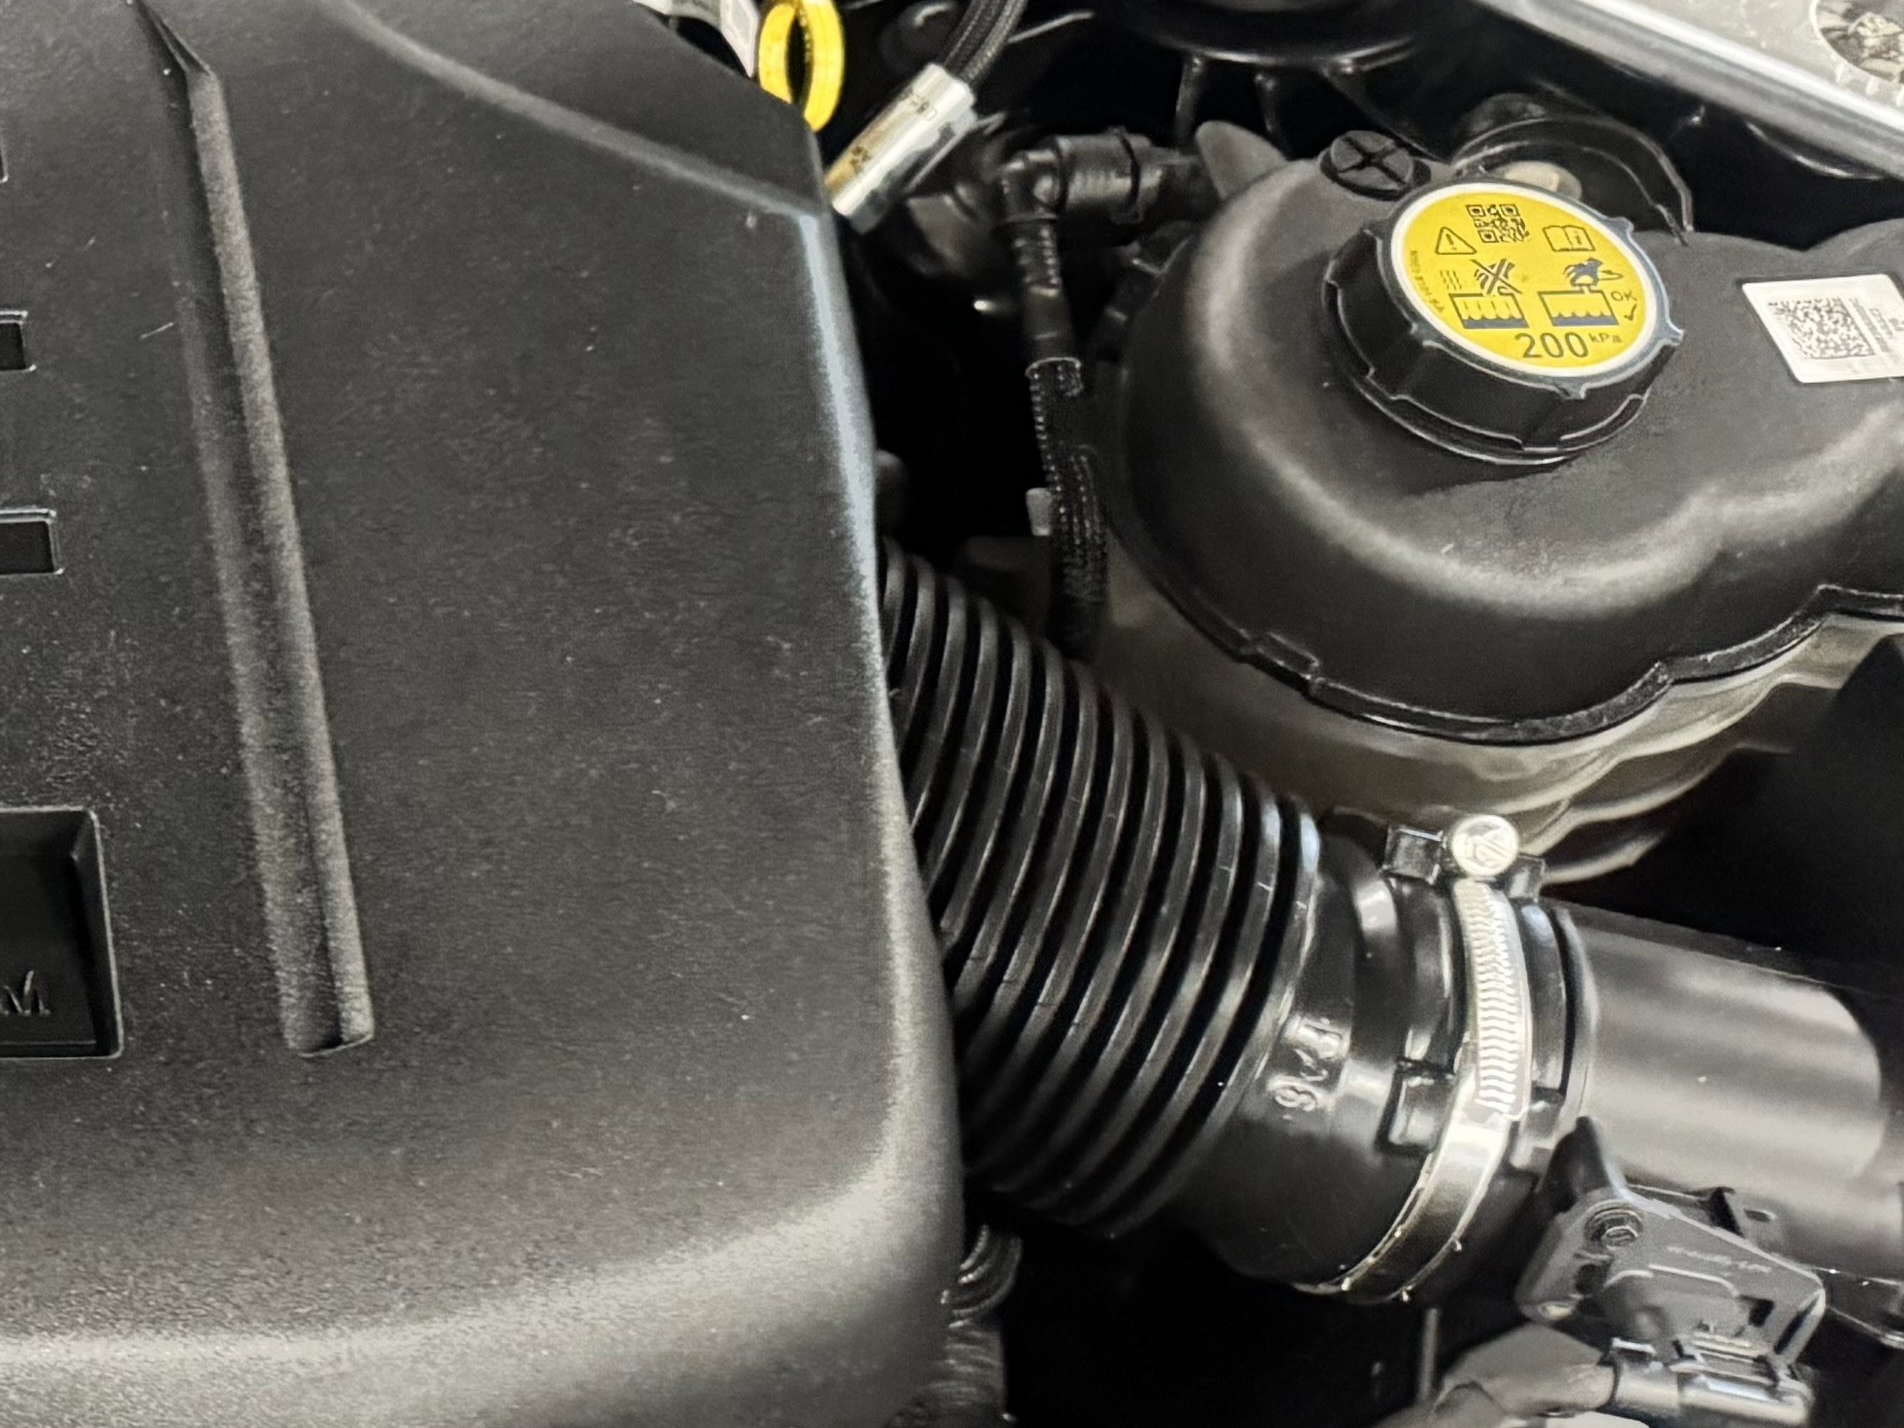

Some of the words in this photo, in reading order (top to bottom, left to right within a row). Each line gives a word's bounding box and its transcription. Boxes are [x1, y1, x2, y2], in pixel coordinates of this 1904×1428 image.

[1610, 290, 1638, 302] OK
[1514, 332, 1589, 358] 200
[1588, 332, 1623, 344] kPa
